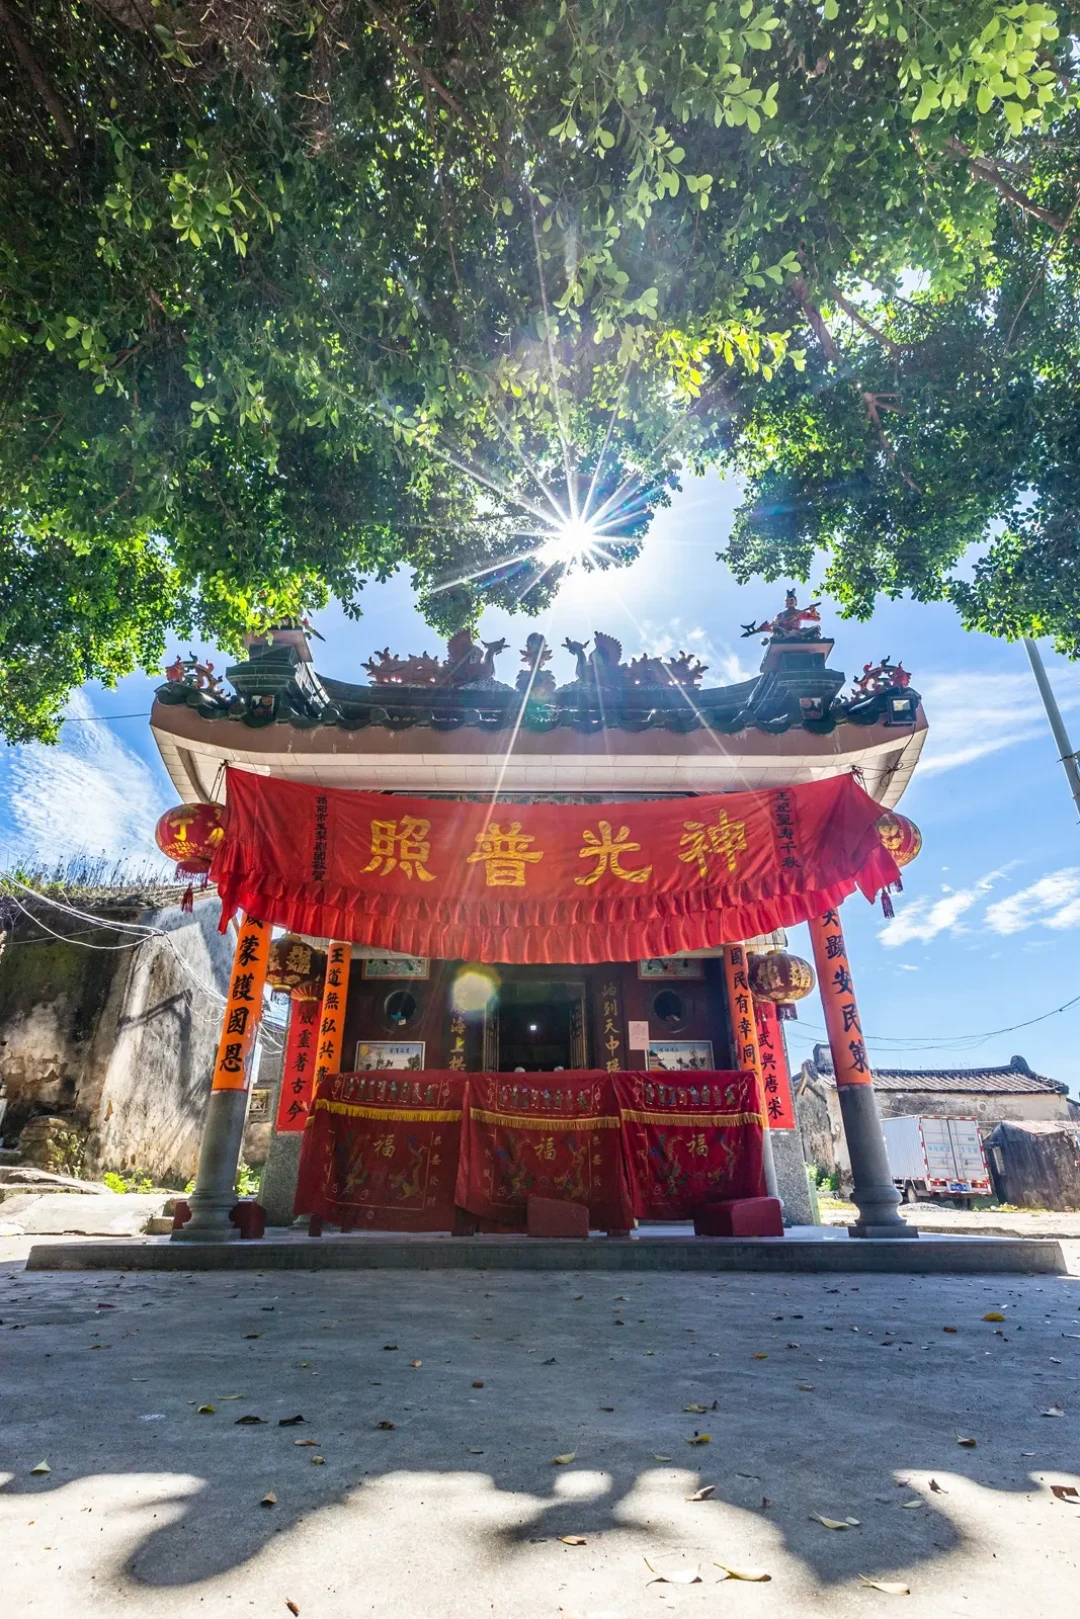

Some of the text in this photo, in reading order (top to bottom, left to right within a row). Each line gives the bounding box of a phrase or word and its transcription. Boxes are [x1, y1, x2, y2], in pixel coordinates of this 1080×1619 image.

[360, 809, 747, 887] 神光普照
[731, 946, 759, 1075] 國民有幸同
[373, 1133, 395, 1158] 福
[534, 1136, 557, 1161] 福
[686, 1133, 708, 1158] 福
